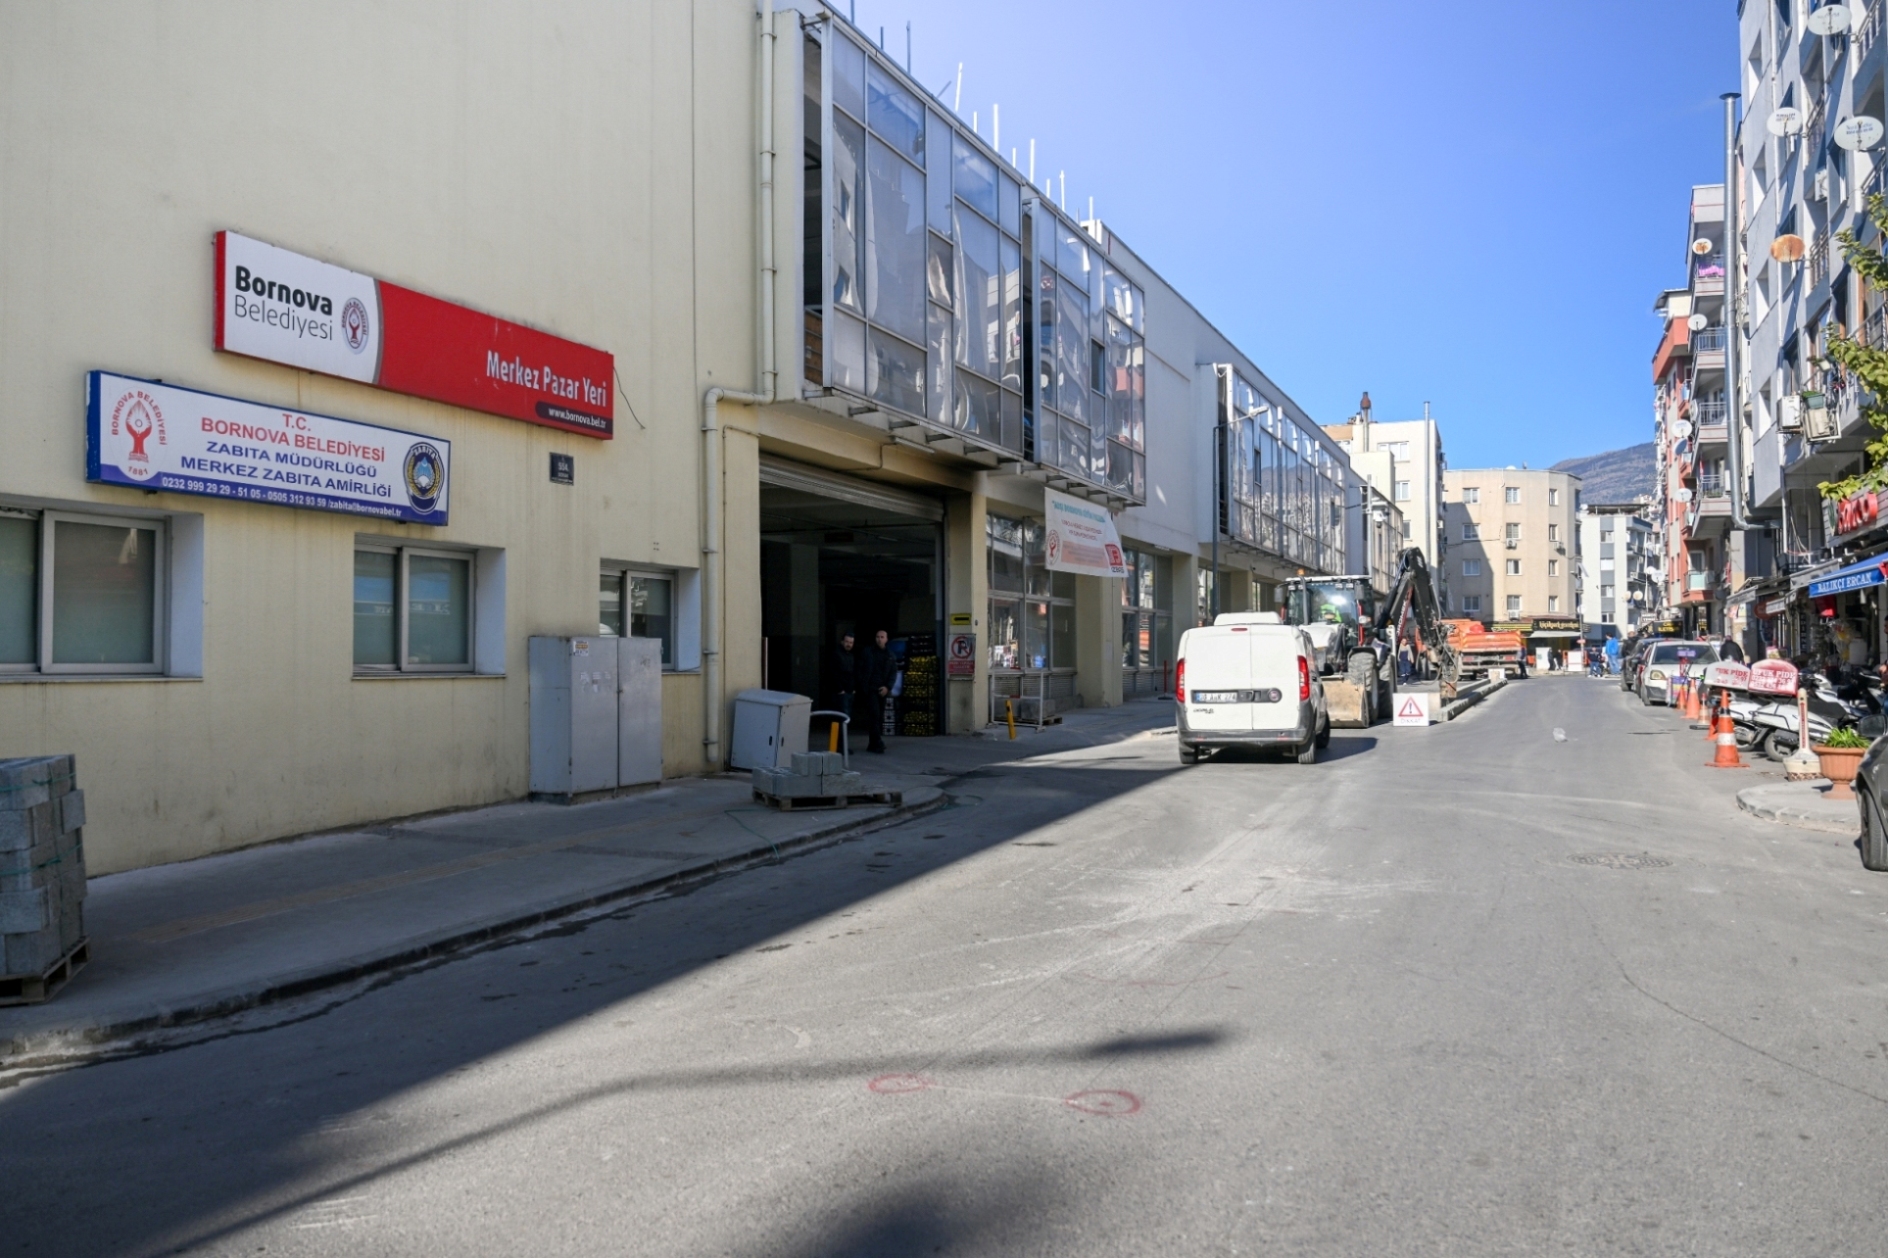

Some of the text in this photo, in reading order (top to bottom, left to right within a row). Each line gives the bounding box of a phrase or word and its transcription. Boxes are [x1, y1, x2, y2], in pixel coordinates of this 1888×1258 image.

[235, 265, 333, 317] Bornova
[234, 294, 333, 341] Belediyesi
[486, 350, 607, 407] Merkez Pazar Yeri
[111, 391, 135, 436] BORNOVA
[282, 413, 312, 432] T.C.
[548, 407, 607, 429] www.bornova.bel.tr
[201, 417, 385, 463] BORNOVA BELEDİYESİ
[206, 441, 377, 478] ZABITA MÜDÜRLÜĞÜ
[128, 466, 149, 476] 1881
[162, 477, 185, 489] 0232
[187, 480, 205, 492] 999
[206, 483, 218, 493] 29
[220, 485, 231, 495] 29
[238, 487, 248, 497] 51
[181, 456, 391, 498] MERKEZ ZABITA AMİRLİĞİ
